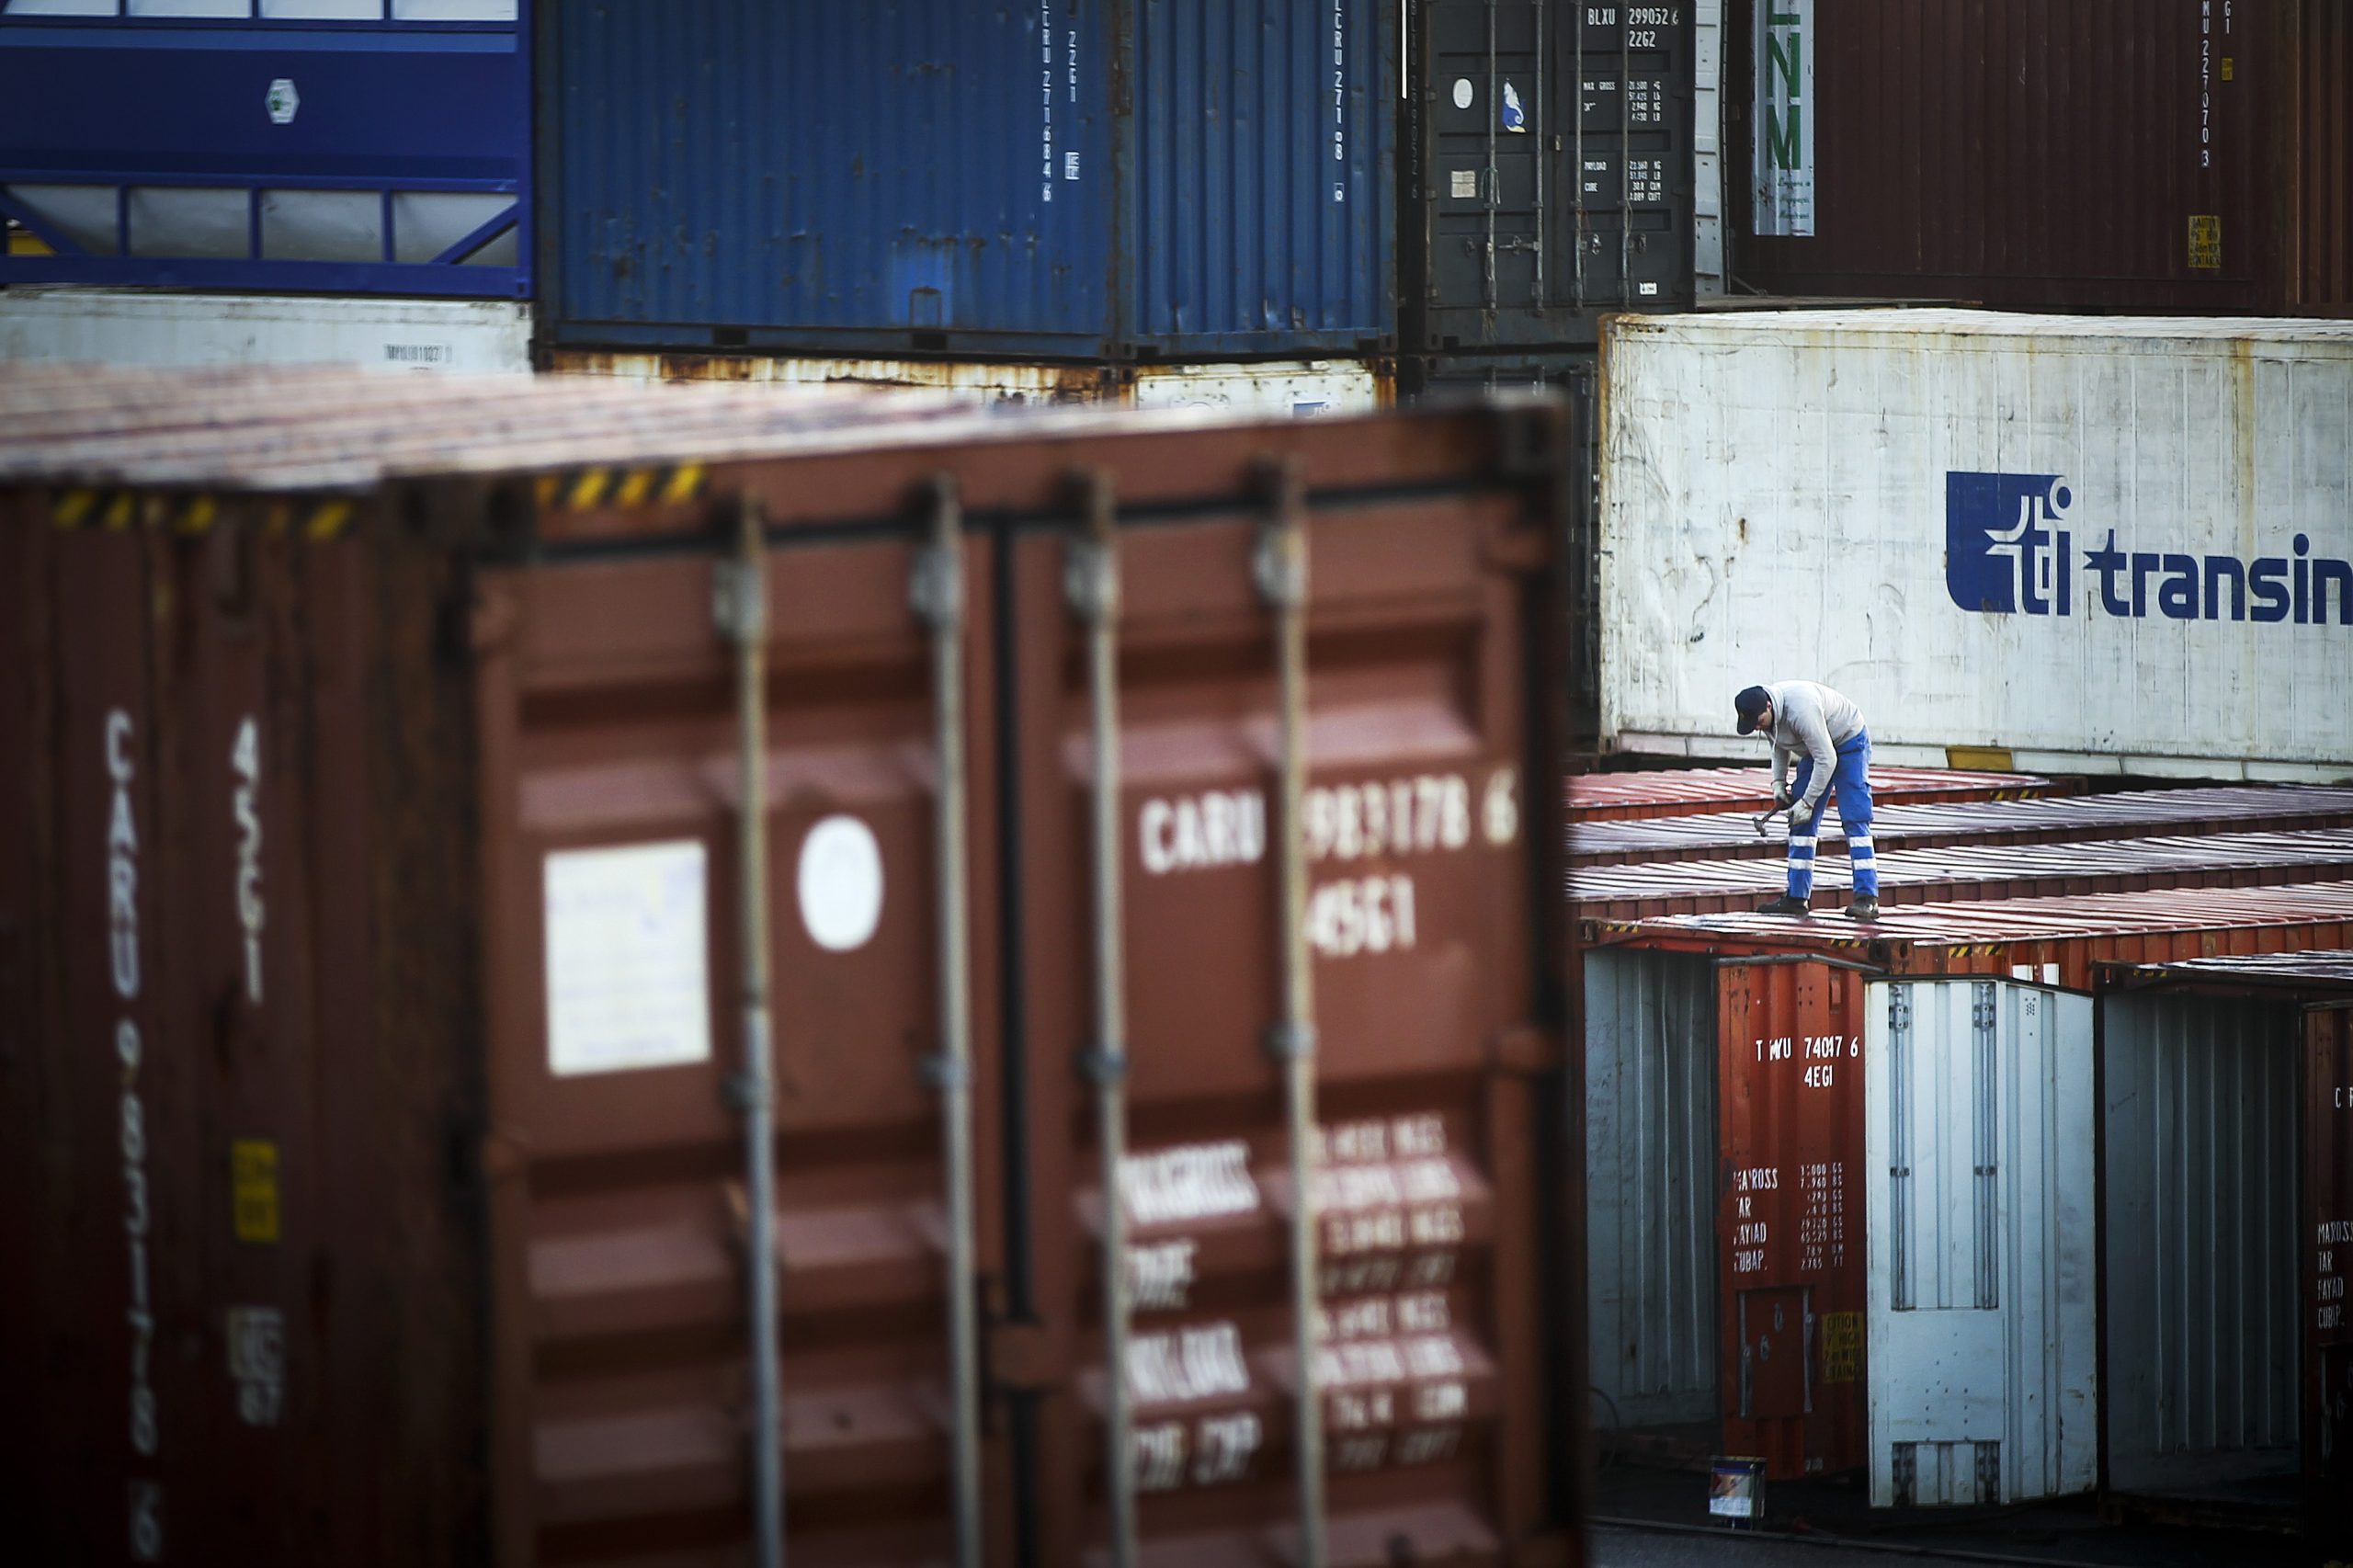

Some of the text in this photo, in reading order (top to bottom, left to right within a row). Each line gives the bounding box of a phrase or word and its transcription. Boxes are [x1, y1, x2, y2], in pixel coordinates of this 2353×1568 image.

[1587, 7, 1616, 26] BLXU
[1628, 7, 1669, 26] 299052
[1629, 30, 1656, 48] 22G2
[2201, 40, 2210, 142] 227070
[1041, 70, 1051, 178] 271684
[1584, 161, 1607, 171] PAYLOAD
[2201, 149, 2210, 166] 3
[1138, 787, 1267, 875] CARU
[1481, 765, 1519, 846] 6
[105, 709, 139, 998] CARU
[1849, 1036, 1858, 1058] 6
